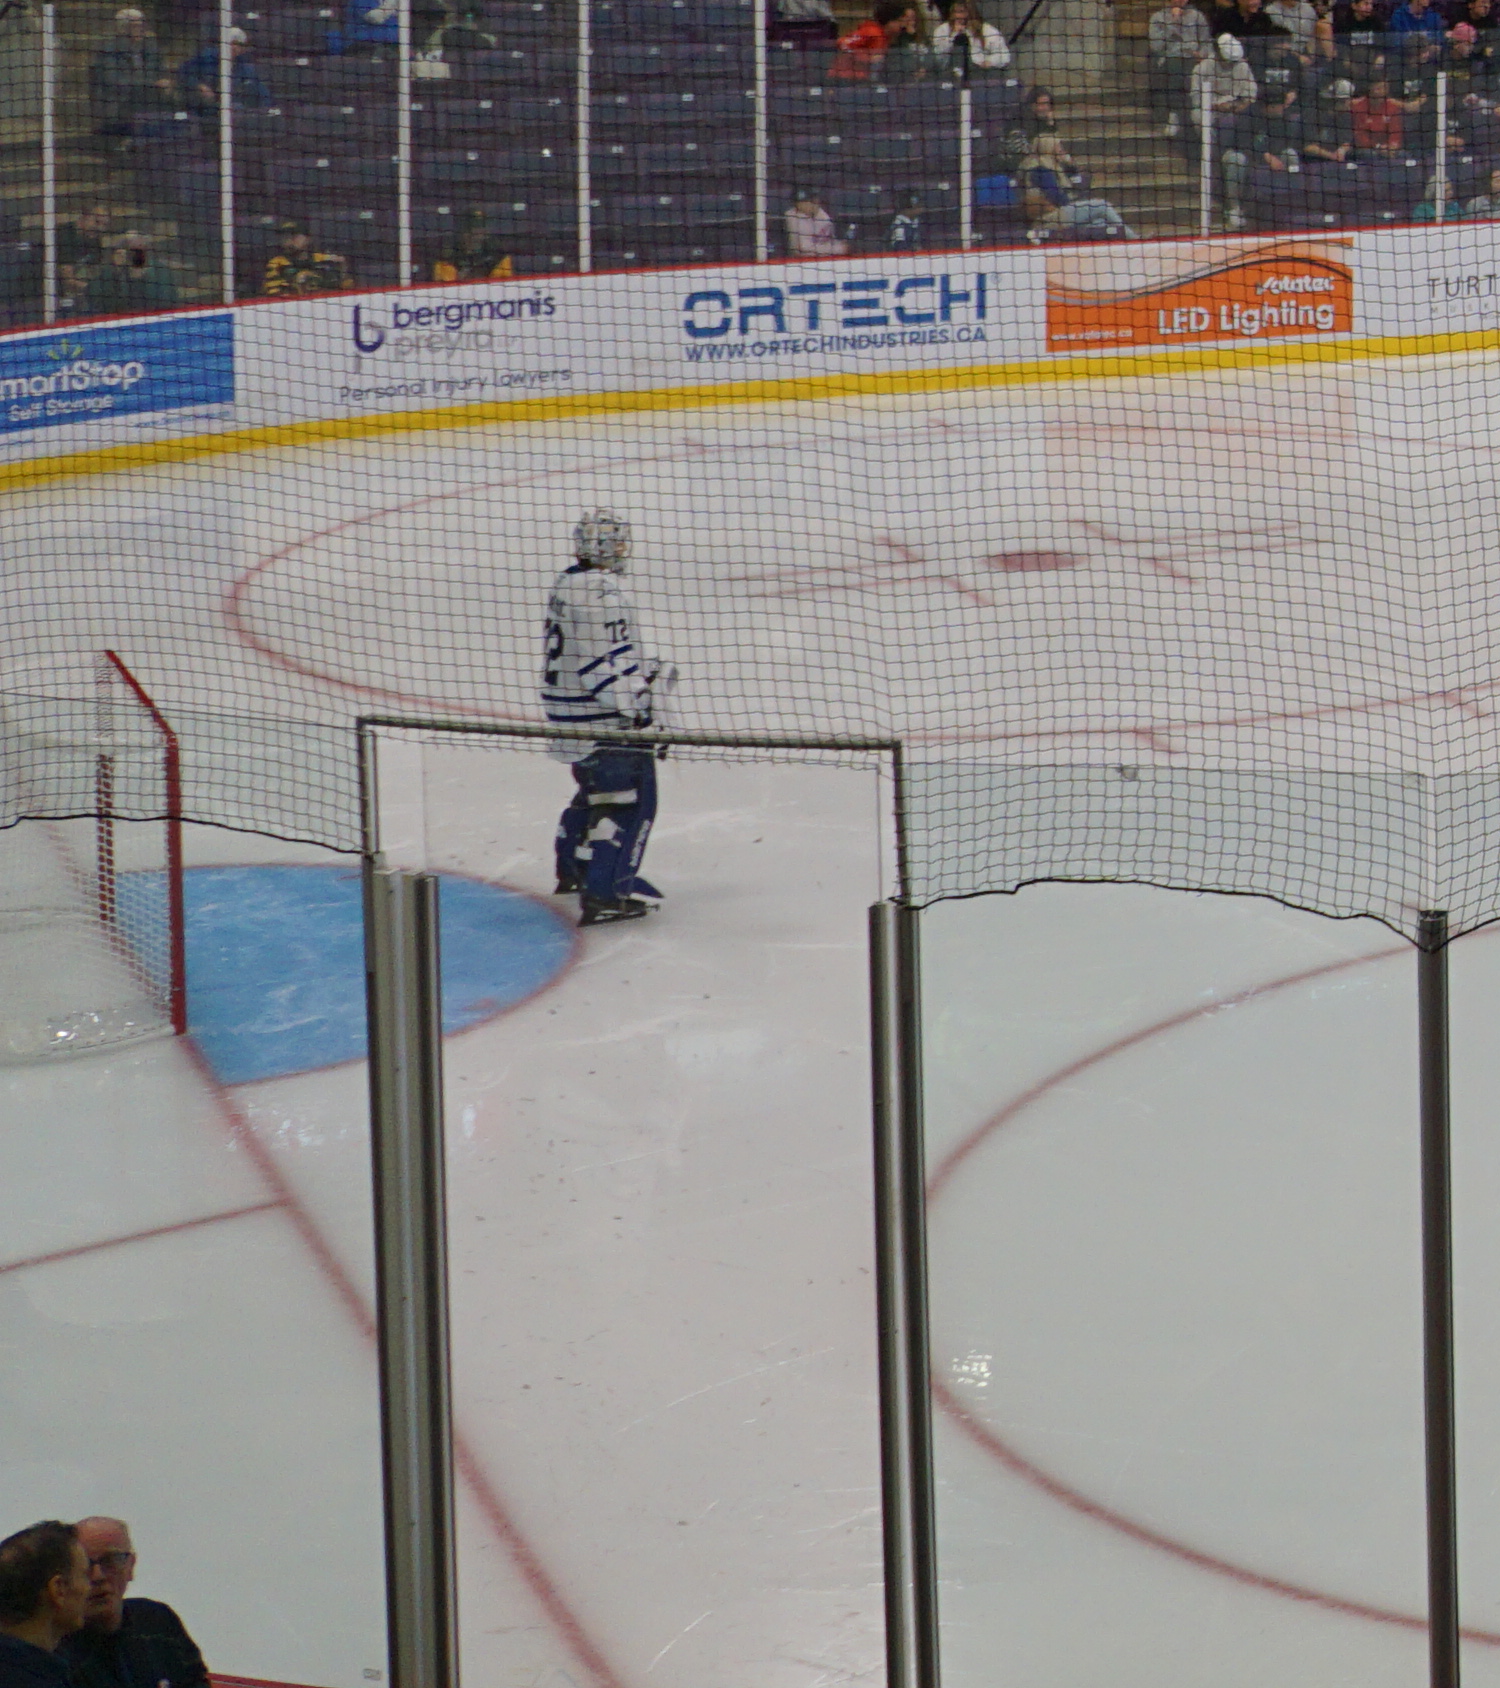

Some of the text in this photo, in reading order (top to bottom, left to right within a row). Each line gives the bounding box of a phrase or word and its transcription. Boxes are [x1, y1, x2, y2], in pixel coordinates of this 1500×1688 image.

[393, 292, 556, 329] bergmanis
[684, 273, 987, 338] ORTECH
[1157, 301, 1335, 336] LED Lighting
[685, 325, 986, 361] WWW.ORTECHINDUSTRIES.CA
[339, 380, 428, 402] Personal
